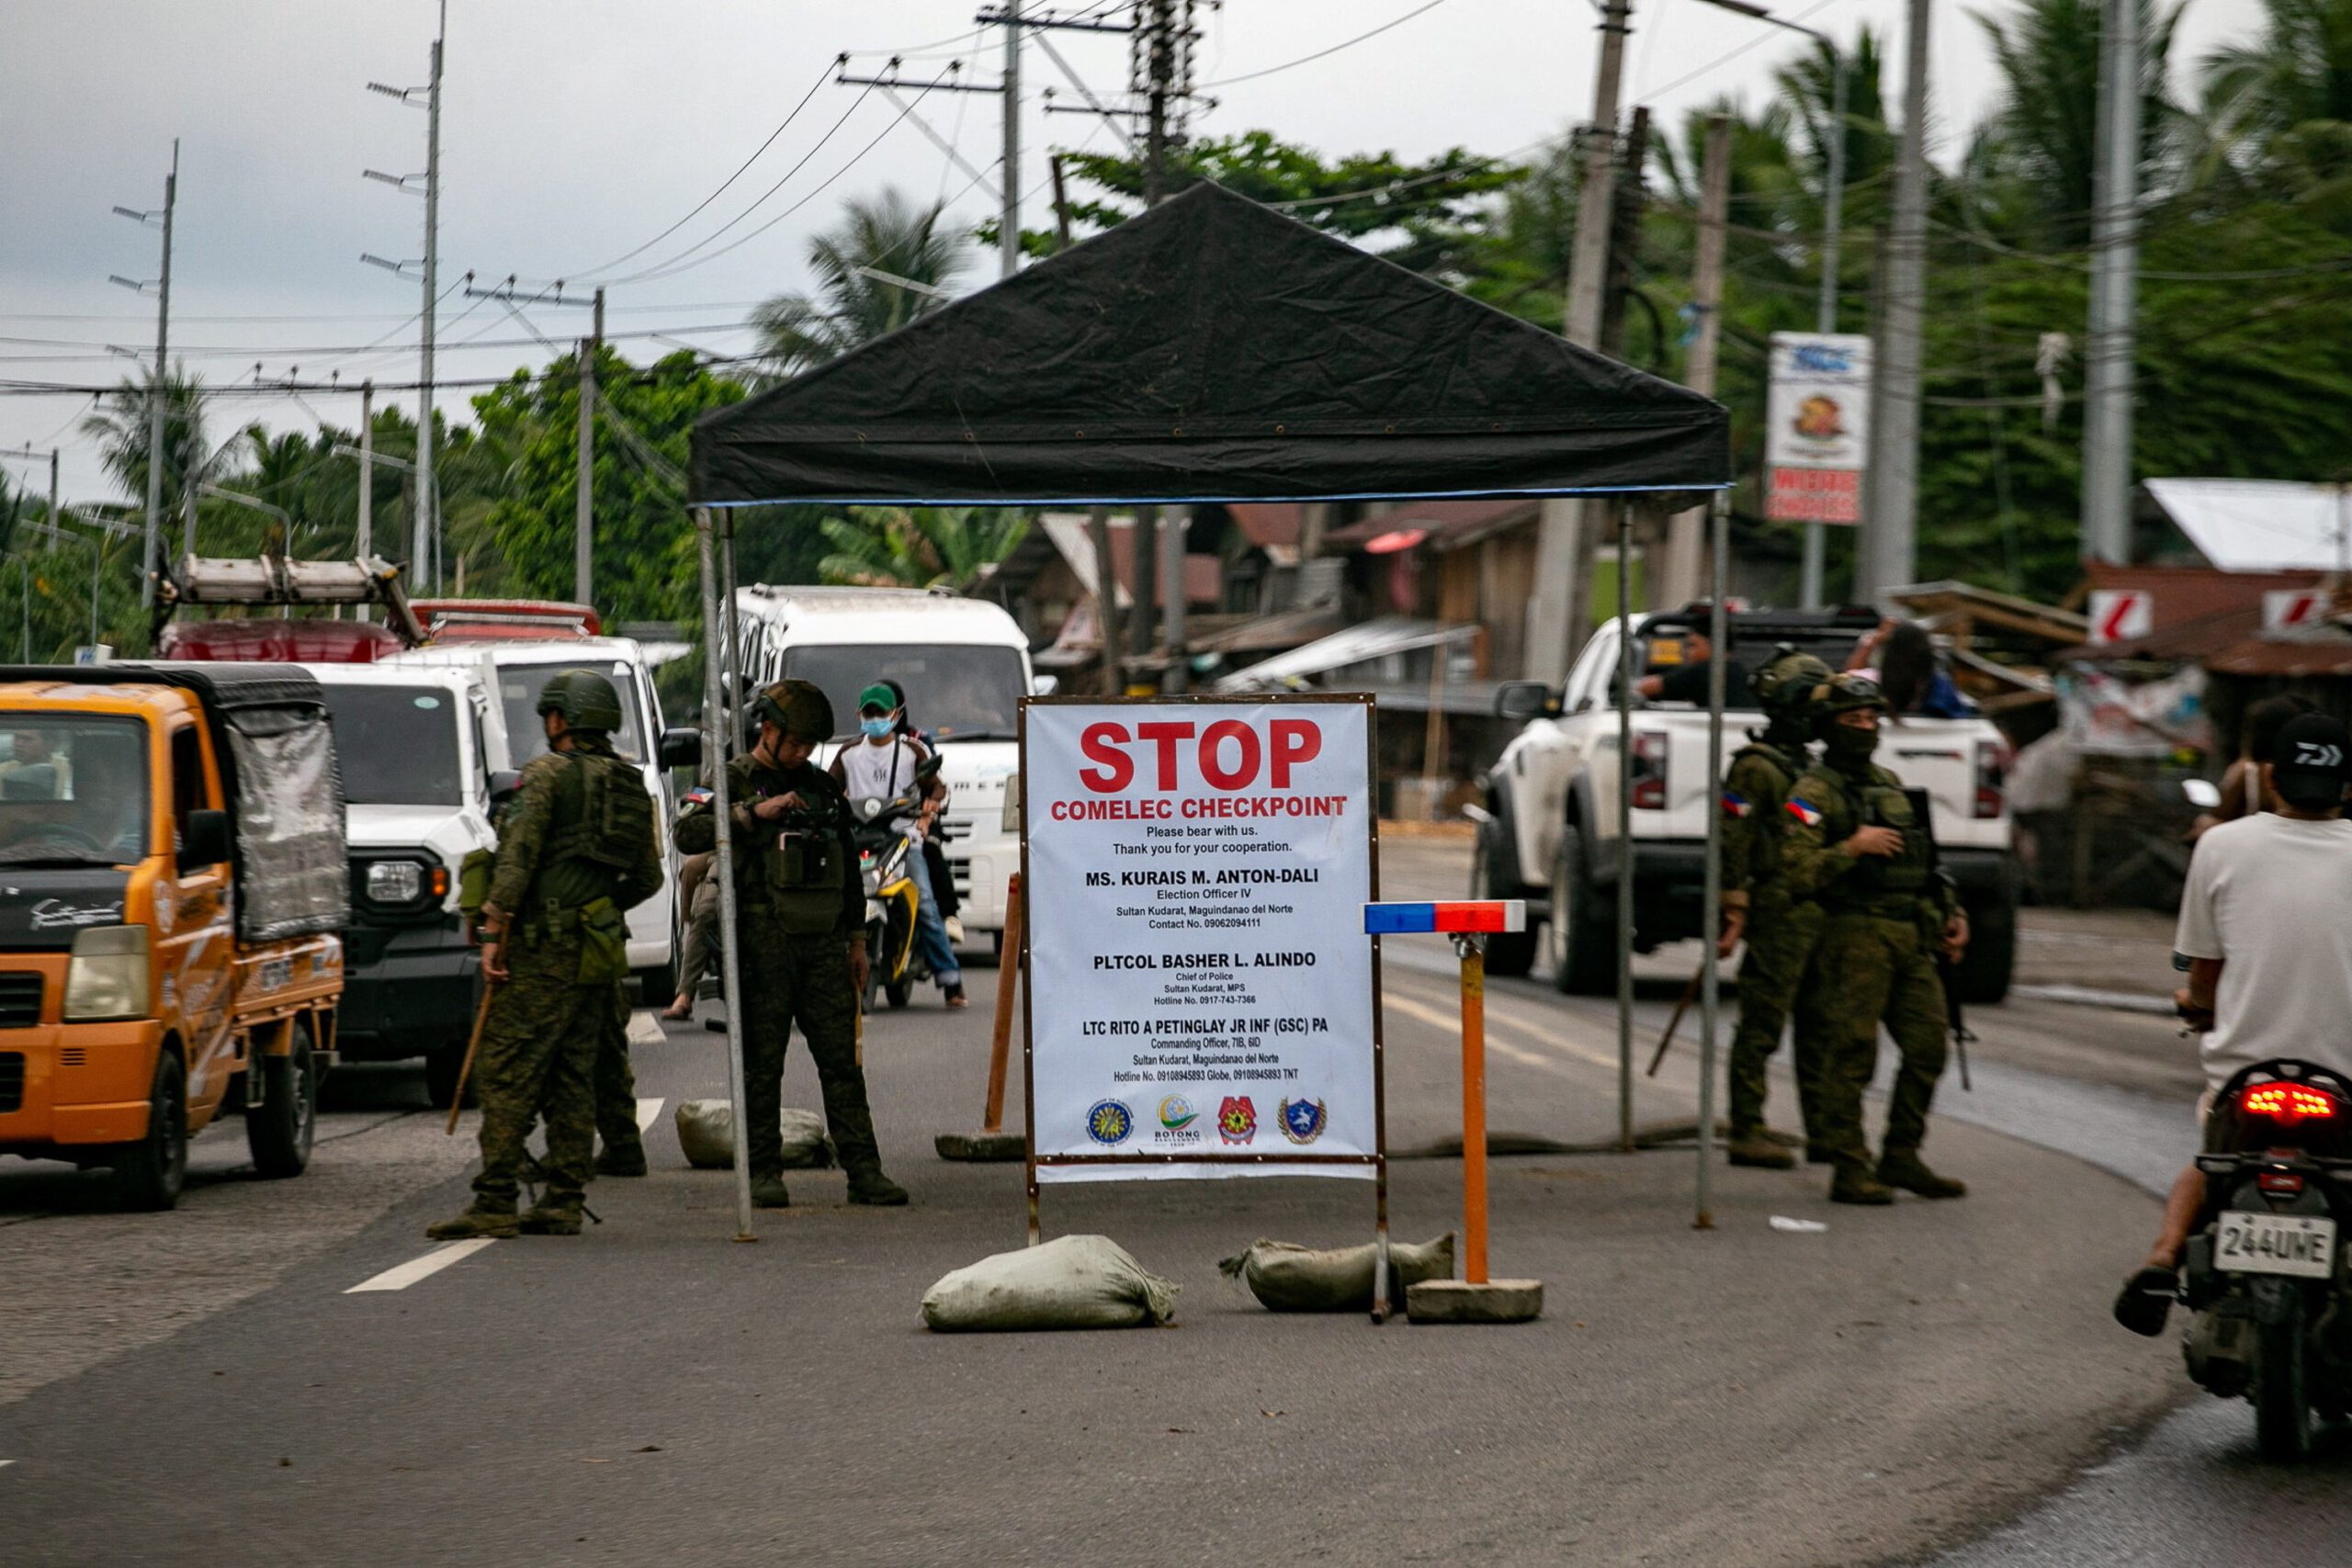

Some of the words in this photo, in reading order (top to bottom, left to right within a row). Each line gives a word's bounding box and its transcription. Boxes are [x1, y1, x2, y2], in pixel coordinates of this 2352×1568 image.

[1080, 719, 1321, 793] STOP
[1050, 798, 1172, 821] COMELEC
[1181, 795, 1347, 819] CHECKPOINT
[1146, 826, 1183, 838] Please
[1186, 825, 1212, 837] bear
[1214, 824, 1238, 837] with
[1240, 826, 1258, 836] us.
[1113, 842, 1148, 855] Thank
[1150, 844, 1171, 857] you
[1174, 841, 1191, 854] for
[1193, 844, 1219, 856] your
[1221, 840, 1292, 855] cooperation.
[1085, 871, 1115, 886] MS.
[1121, 870, 1186, 886] KURAIS
[1192, 870, 1210, 885] M.
[1215, 867, 1318, 885] ANTON-DALI
[1157, 889, 1199, 900] Election
[1202, 888, 1238, 899] Officer
[1240, 887, 1251, 898] IV
[1116, 906, 1145, 917] Sultan
[1148, 906, 1186, 918] Kudarat,
[1188, 904, 1250, 918] Maguindanao
[1251, 904, 1265, 914] del
[1268, 904, 1293, 914] Norte
[1148, 919, 1184, 930] Contact
[1186, 919, 1202, 929] No.
[1204, 918, 1260, 929] 09062094111
[1093, 954, 1157, 970] PLTCOL
[1161, 953, 1229, 969] BASHER
[1234, 953, 1249, 968] L.
[1253, 952, 1316, 967] ALINDO
[1175, 972, 1196, 982] Chief
[1198, 972, 1206, 981] of
[1208, 971, 1233, 981] Police
[1164, 984, 1190, 994] Sultan
[1191, 984, 1225, 994] Kudarat,
[1227, 983, 1245, 992] MPS
[1153, 996, 1182, 1006] Hotline
[1183, 996, 1197, 1005] No.
[1082, 1021, 1106, 1036] LTC
[1110, 1020, 1139, 1035] RITO
[1143, 1020, 1152, 1035] A
[1155, 1019, 1226, 1035] PETINGLAY
[1229, 1018, 1246, 1033] JR
[1250, 1018, 1270, 1033] INF
[1273, 1017, 1308, 1036] (GSC)
[1312, 1017, 1329, 1032] PA
[1151, 1039, 1202, 1051] Commanding
[1203, 1038, 1230, 1050] Officer,
[1133, 1054, 1157, 1066] Sultan
[1159, 1054, 1191, 1067] Kudarat,
[1193, 1053, 1243, 1067] Maguindanao
[1244, 1053, 1256, 1065] del
[1258, 1052, 1279, 1064] Norte
[1114, 1070, 1140, 1082] Hotline
[1142, 1070, 1154, 1082] No.
[1206, 1069, 1231, 1081] Globe,
[1283, 1067, 1298, 1079] TNT
